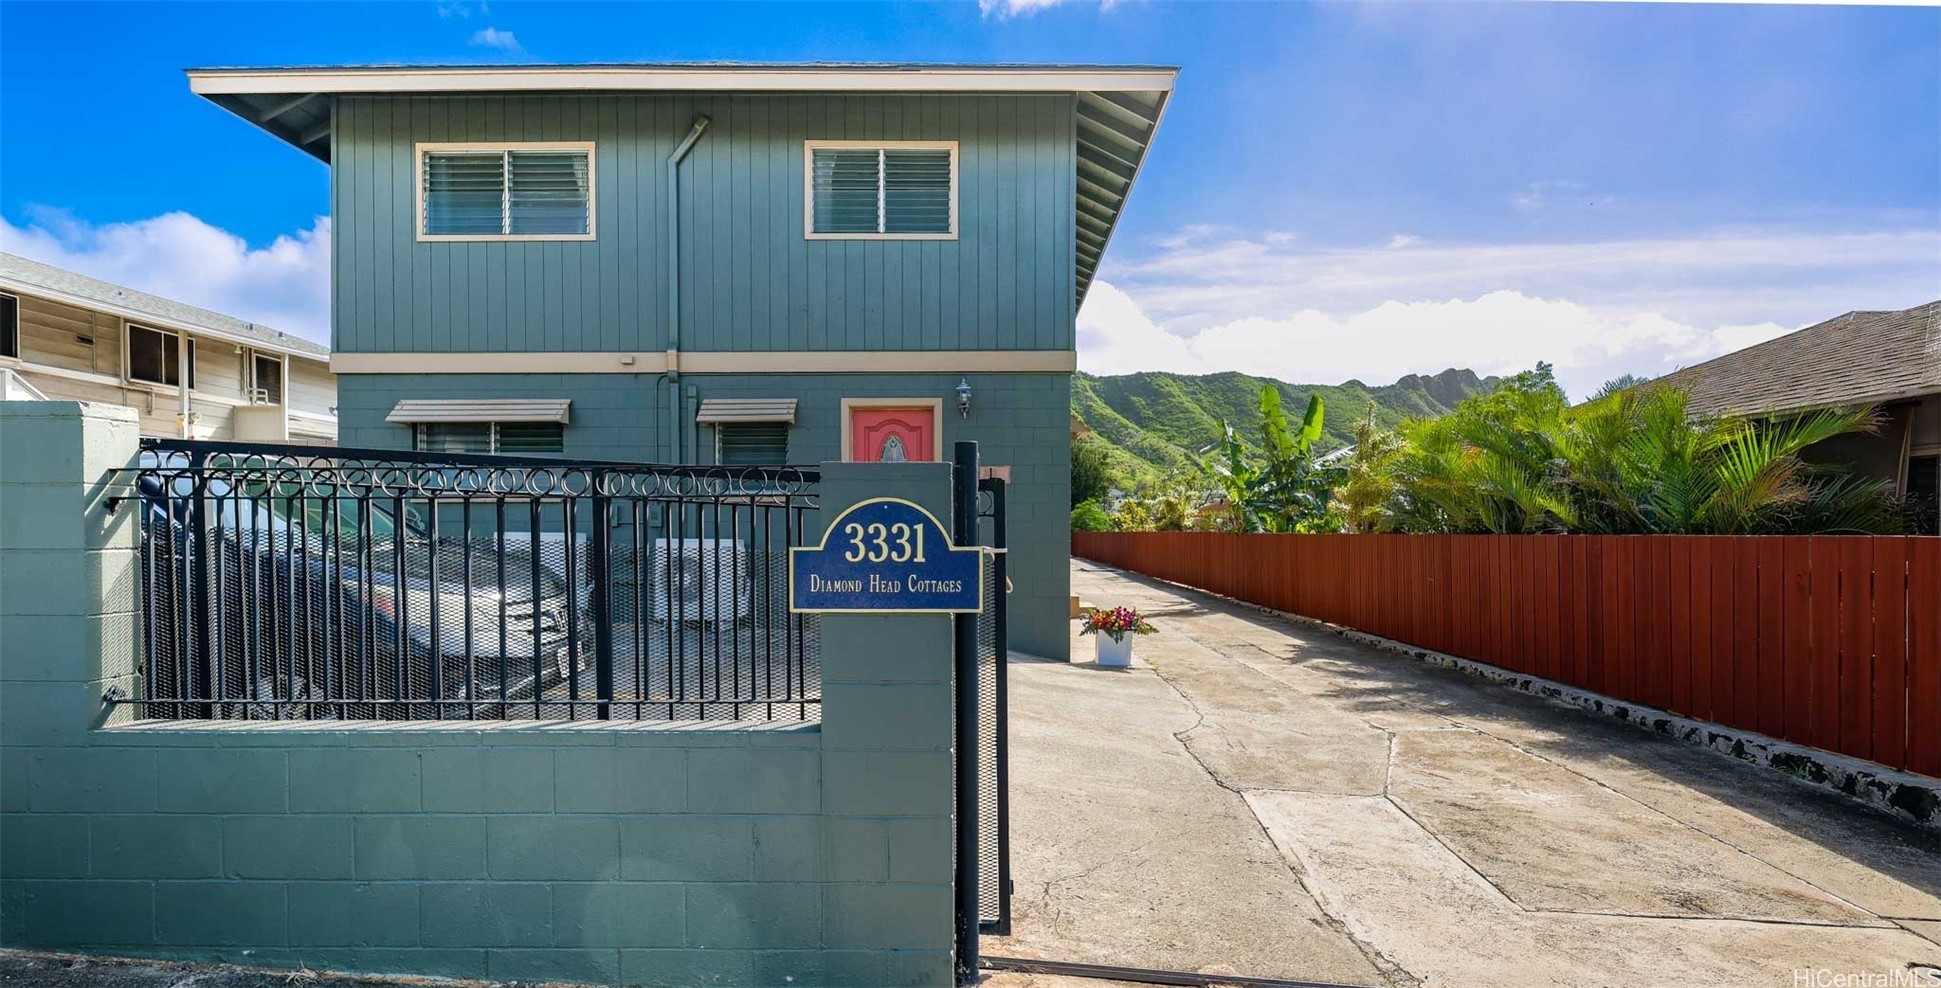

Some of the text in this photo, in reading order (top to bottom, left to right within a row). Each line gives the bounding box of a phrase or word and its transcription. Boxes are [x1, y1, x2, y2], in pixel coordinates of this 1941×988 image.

[845, 522, 925, 562] 3331
[810, 574, 962, 593] DIAMOND HEAD COTTAGES
